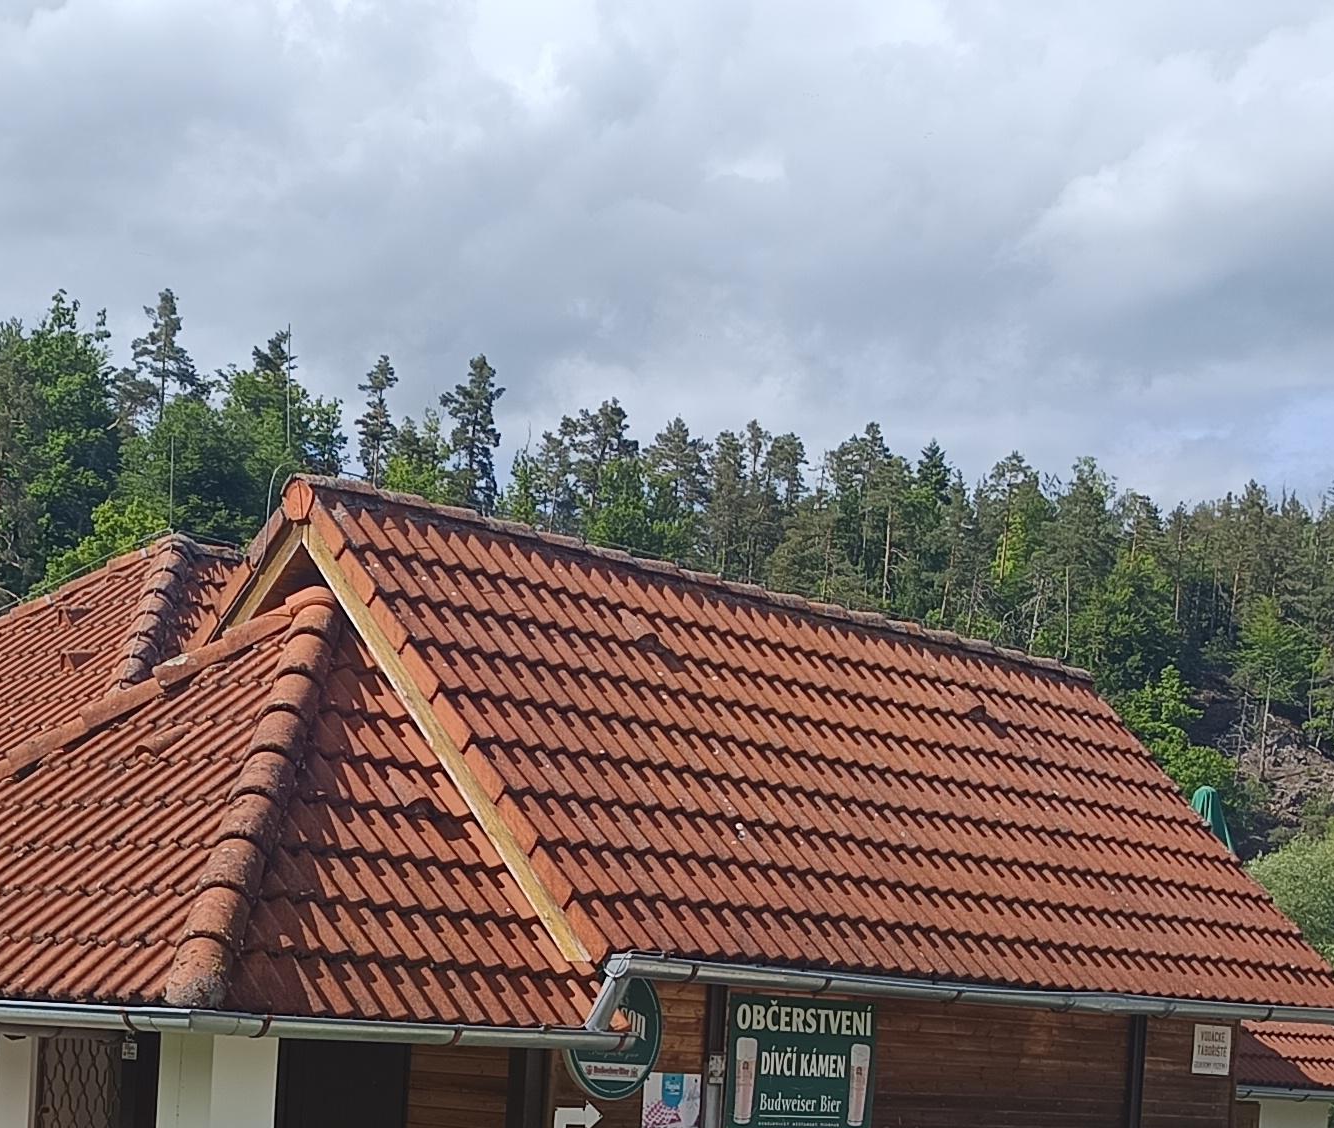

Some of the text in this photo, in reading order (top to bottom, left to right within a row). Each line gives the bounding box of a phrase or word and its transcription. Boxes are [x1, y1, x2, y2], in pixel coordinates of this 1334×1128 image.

[736, 1000, 873, 1037] OBČERSTVENÍ
[760, 1045, 846, 1078] DÍVČÍ KÁMEN
[759, 1091, 842, 1113] Budweiser Bier
